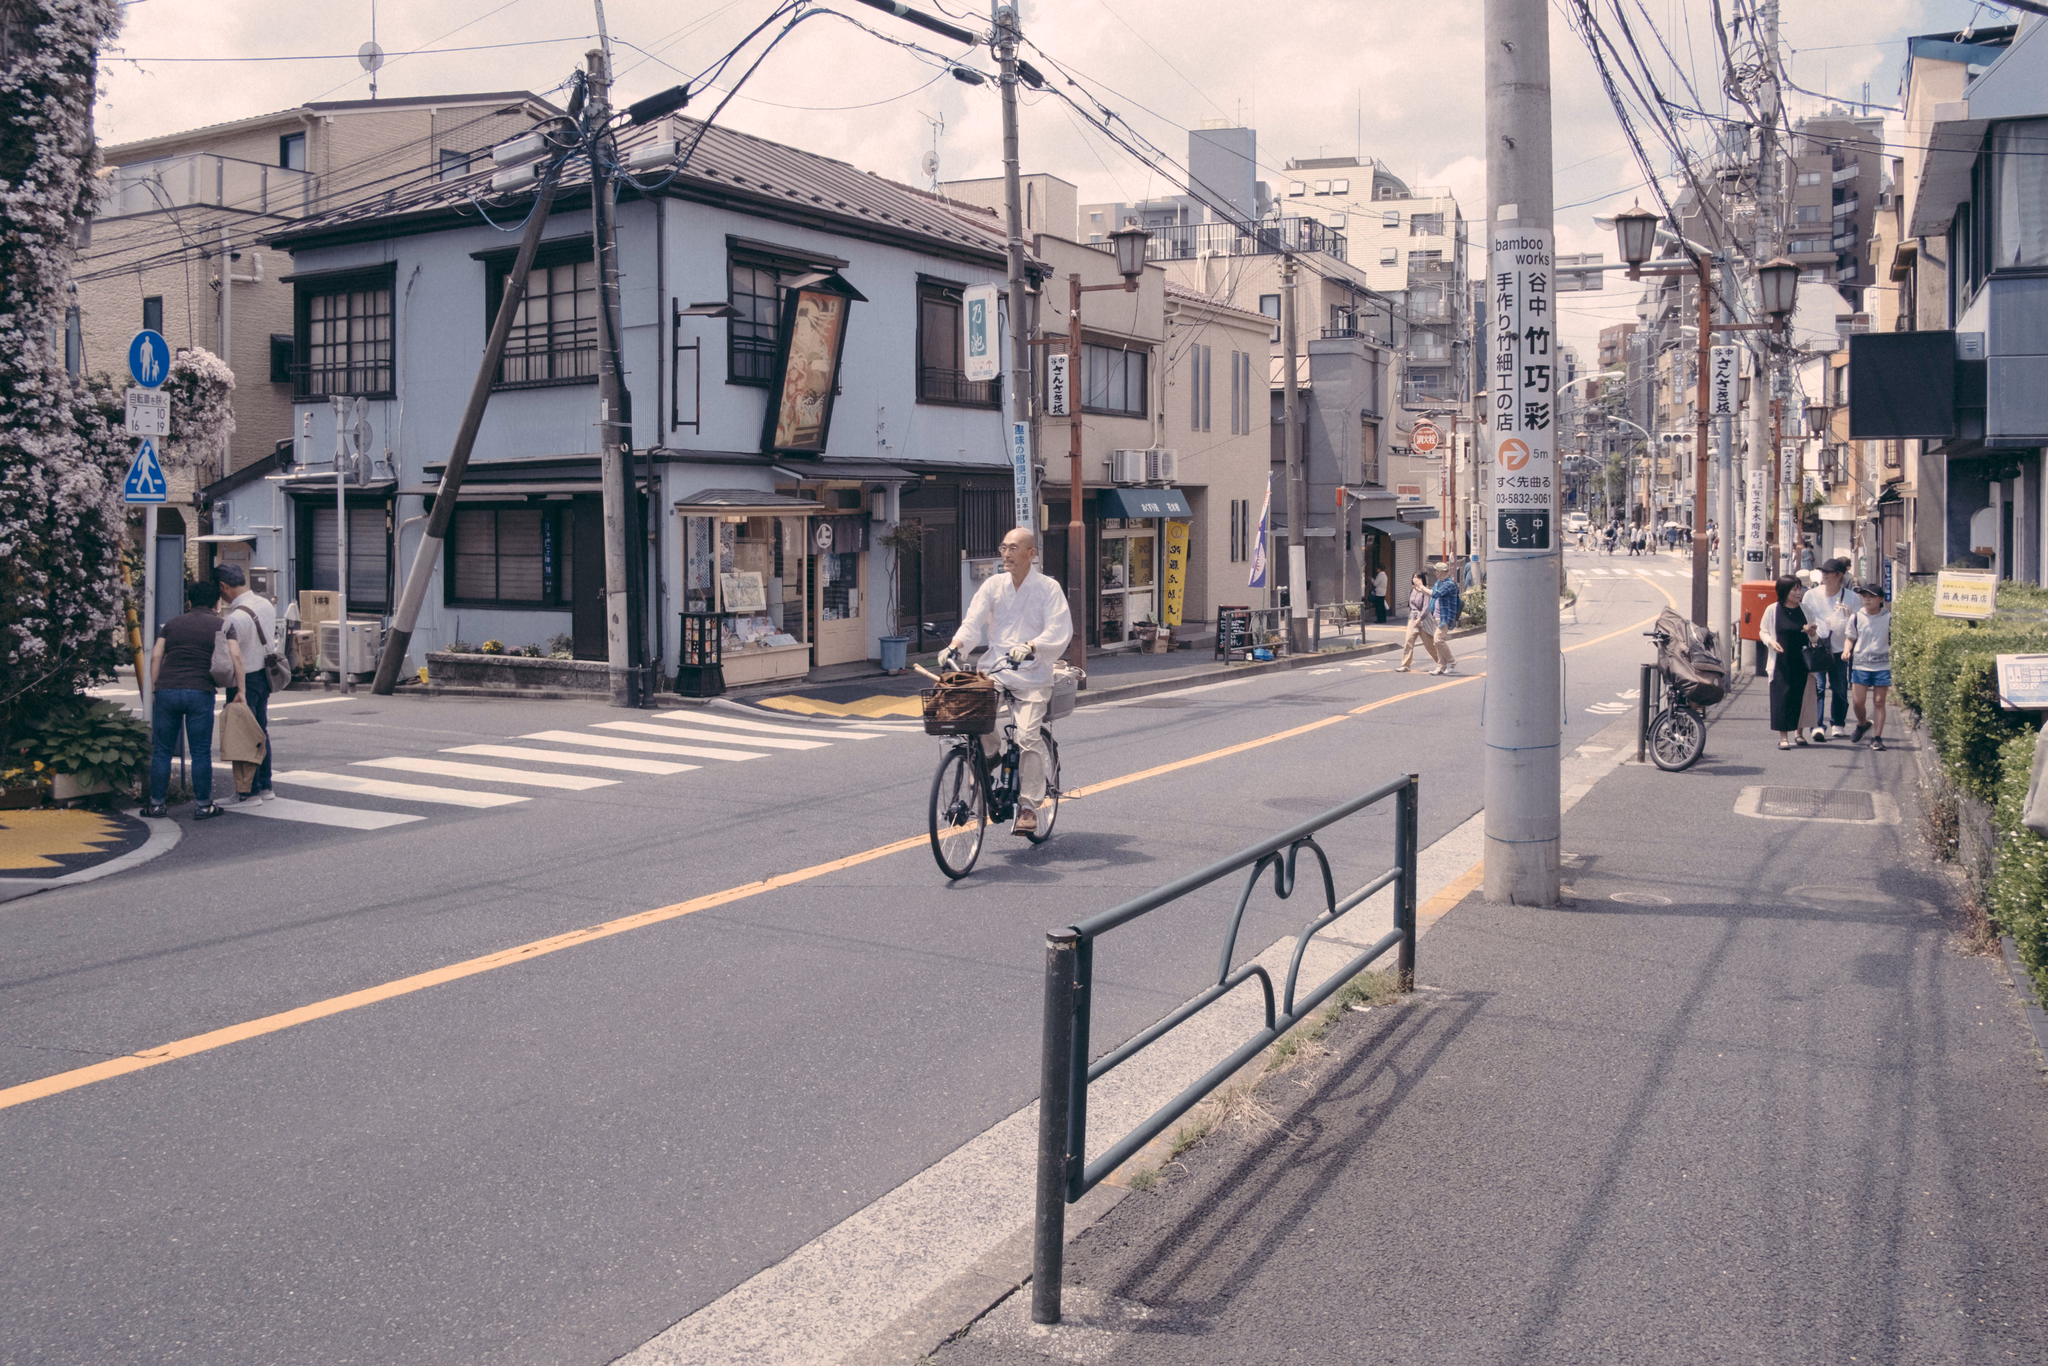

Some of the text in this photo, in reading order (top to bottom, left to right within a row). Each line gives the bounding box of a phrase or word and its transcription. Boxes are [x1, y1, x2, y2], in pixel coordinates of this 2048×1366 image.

[1495, 236, 1543, 251] bamboo
[1515, 251, 1550, 266] works
[986, 290, 993, 314] すし
[1496, 271, 1513, 432] 手作り竹細工の店
[1524, 272, 1550, 431] 谷中 竹巧彩
[1714, 348, 1734, 357] 谷中
[1051, 357, 1065, 366] 谷中
[1052, 365, 1065, 414] さんさき坂
[1715, 357, 1731, 414] さんさき坂
[130, 393, 168, 406] 自転車を除く
[132, 406, 138, 418] 7
[157, 408, 166, 420] 10
[131, 419, 140, 432] 16
[157, 421, 165, 433] 19
[1416, 434, 1437, 445] 消火栓
[1533, 448, 1549, 459] 5m
[1014, 425, 1027, 497] 趣味の郵便切手
[1496, 476, 1551, 488] すぐ先曲る
[1496, 493, 1551, 504] 03-5832-9061
[1505, 518, 1544, 530] 谷中
[1511, 533, 1537, 544] 3-1
[1942, 592, 1988, 603] 箱義桐箱店
